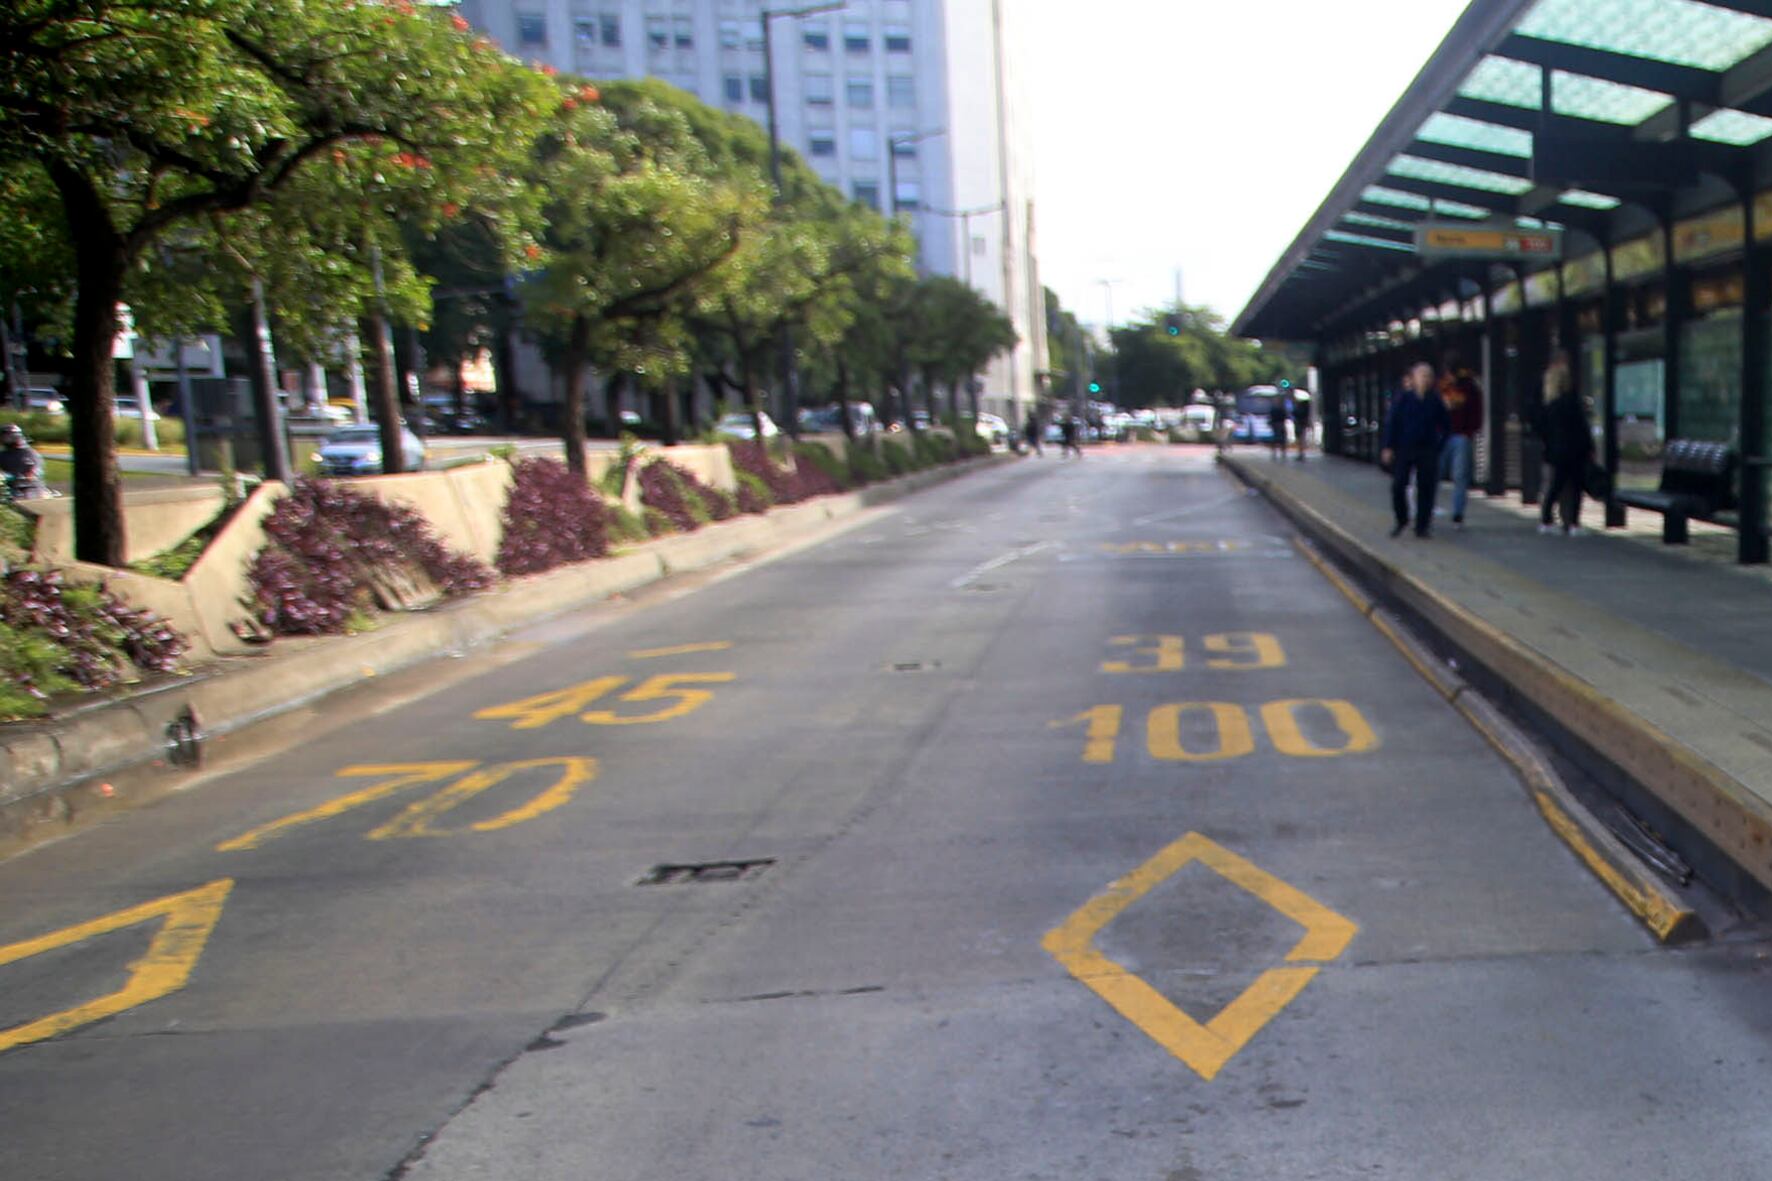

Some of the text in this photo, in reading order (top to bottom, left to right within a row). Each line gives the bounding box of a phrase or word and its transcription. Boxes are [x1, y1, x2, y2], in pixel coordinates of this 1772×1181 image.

[1101, 631, 1288, 674] 39
[474, 671, 737, 729] 45
[1047, 698, 1381, 763] 100
[214, 755, 599, 852] 70
